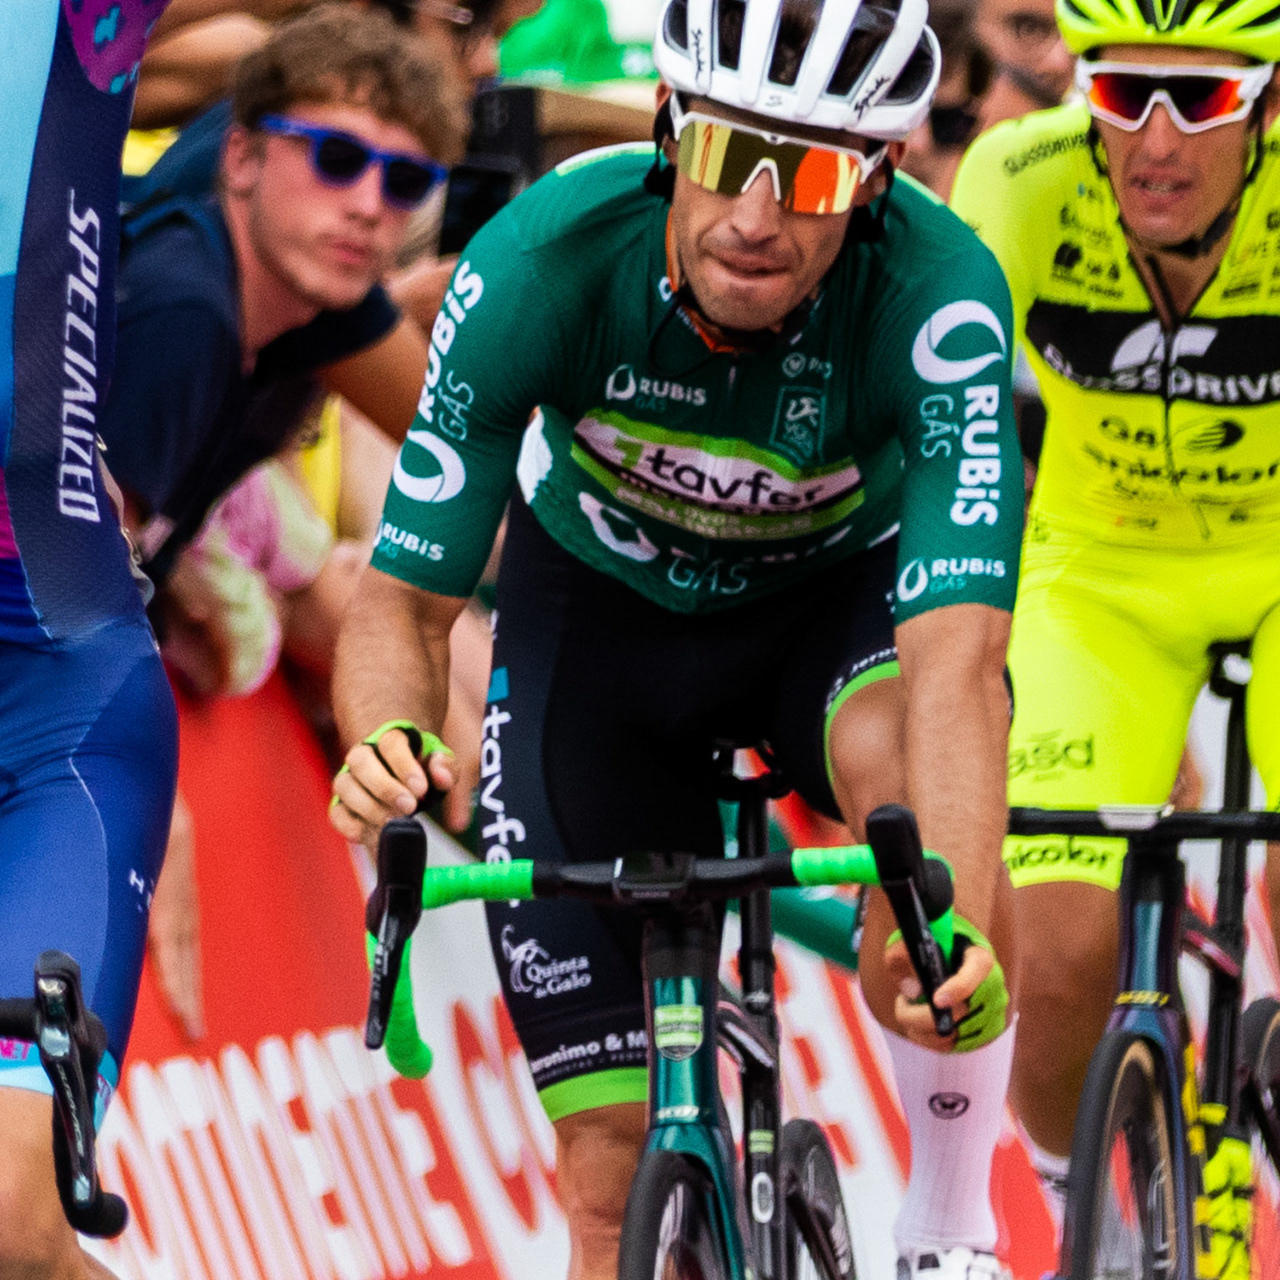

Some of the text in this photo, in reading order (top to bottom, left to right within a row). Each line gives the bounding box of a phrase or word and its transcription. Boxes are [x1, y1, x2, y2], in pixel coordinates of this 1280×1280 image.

[58, 188, 102, 524] SPECIALIZED
[644, 447, 824, 508] tavfer
[480, 704, 527, 909] tavfe
[526, 955, 590, 985] Quinta
[546, 972, 592, 995] Galo
[80, 1023, 473, 1280] ONTINENTE
